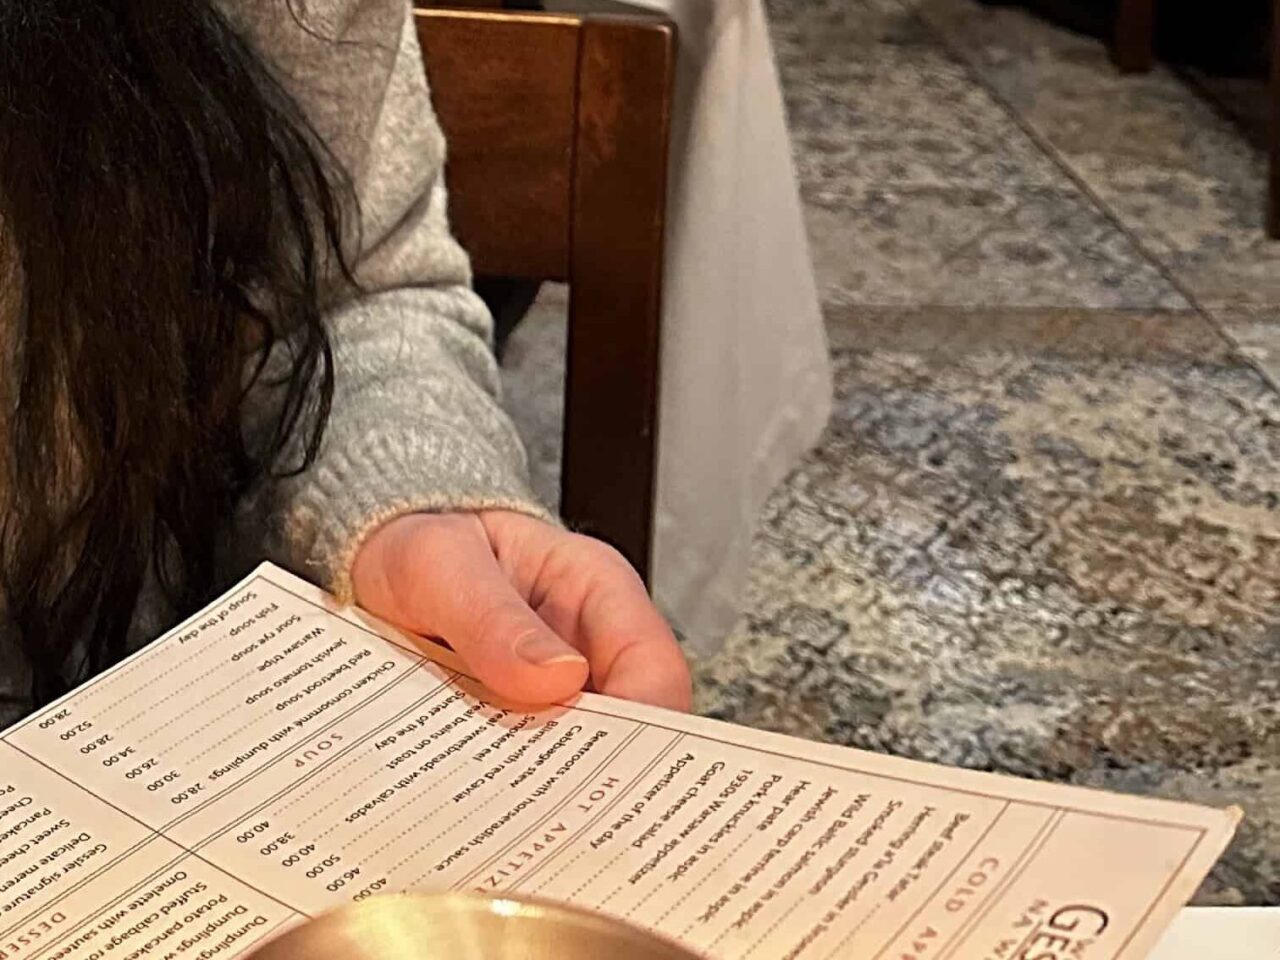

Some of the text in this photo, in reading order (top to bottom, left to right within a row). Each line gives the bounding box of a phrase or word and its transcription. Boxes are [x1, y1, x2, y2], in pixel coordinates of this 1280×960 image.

[38, 591, 258, 729] Soup of the day 28.00
[59, 602, 279, 741] Fish soup 52.00
[79, 614, 302, 754] Sour rye soup 28.00
[102, 627, 325, 767] Warsaw tripe 34.00
[124, 637, 348, 780] Jewish tomato soup 26.00
[146, 649, 372, 792] Red beetroot soup 30.00
[170, 661, 396, 805] Chicken consommé with dumplings 28.00
[236, 689, 471, 844] Starter of the day 40.00
[259, 698, 495, 856] Veal brains on toast 38.00
[294, 732, 344, 769] SOUP
[509, 767, 537, 788] stew
[534, 725, 583, 767] Cabbage
[281, 707, 518, 867] Veal sweetbreads with calvados 40.00
[305, 713, 536, 879] Smoked eel 50.00
[326, 719, 559, 892] Blinis with red caviar 46.00
[434, 730, 609, 872] Beetroots with horseradish sauce
[577, 776, 620, 813] HOT
[589, 752, 695, 850] Appetizer of the day
[631, 761, 726, 849] Goat cheese salad
[756, 780, 812, 832] Hear pate
[29, 819, 71, 845] Sweet
[39, 832, 92, 866] Delicate
[62, 843, 108, 874] Gessler
[628, 769, 754, 885] 1930s Warsaw appetizer
[666, 774, 783, 882] Pork knuckles in aspic
[697, 786, 839, 923] Jewish carp terrine in aspic
[730, 794, 871, 929] Wild Baltic salmon in aspic
[808, 800, 903, 895] Smoked sturgeon
[888, 806, 936, 850] Herring
[940, 813, 970, 841] Beef
[2, 872, 62, 912] signature
[97, 910, 128, 930] with
[127, 871, 188, 911] Omelette
[159, 881, 208, 916] Stuffed
[183, 893, 228, 923] Potato
[822, 911, 839, 923] in
[944, 857, 1000, 913] COLD
[1012, 899, 1049, 929] NA
[104, 912, 160, 951] cabbage
[176, 904, 249, 952] Dumplings
